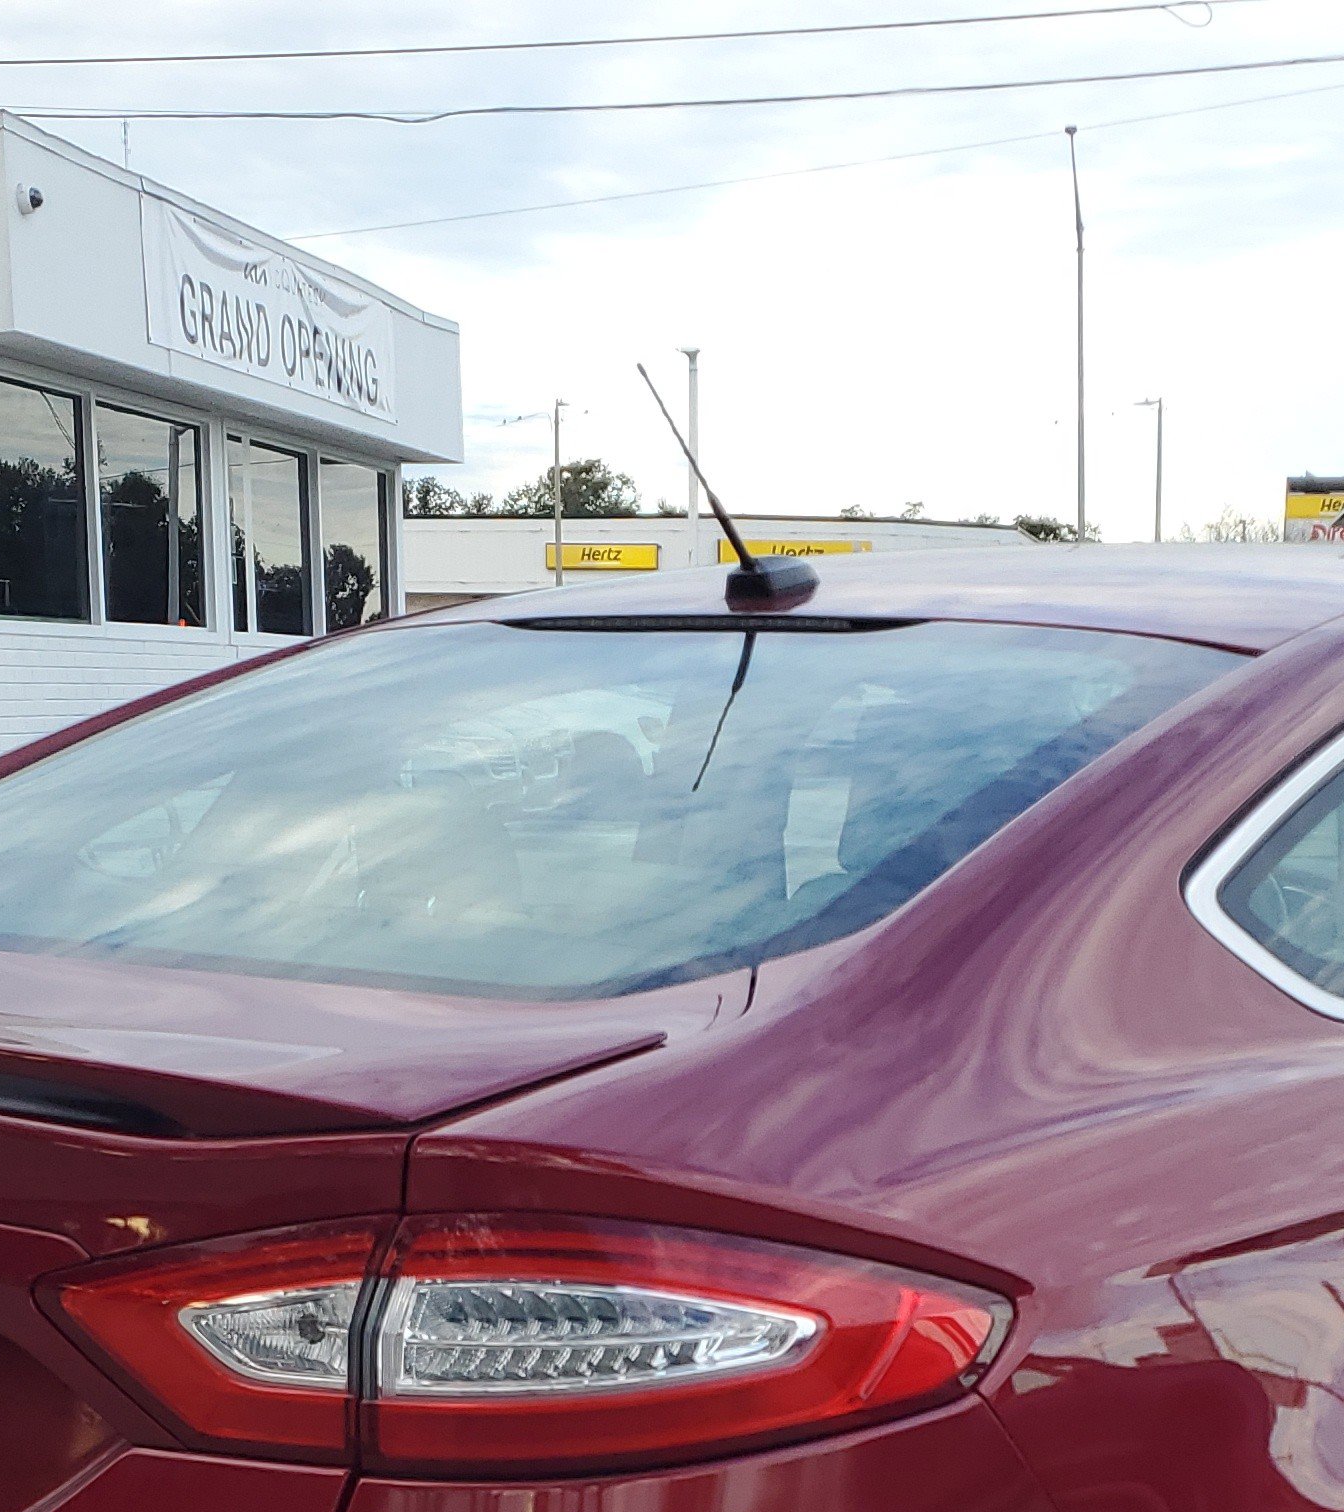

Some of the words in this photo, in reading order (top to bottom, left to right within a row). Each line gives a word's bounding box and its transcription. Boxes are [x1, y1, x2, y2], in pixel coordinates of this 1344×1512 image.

[180, 273, 271, 368] GRAND
[280, 313, 379, 406] OPENING
[581, 547, 622, 561] Hertz
